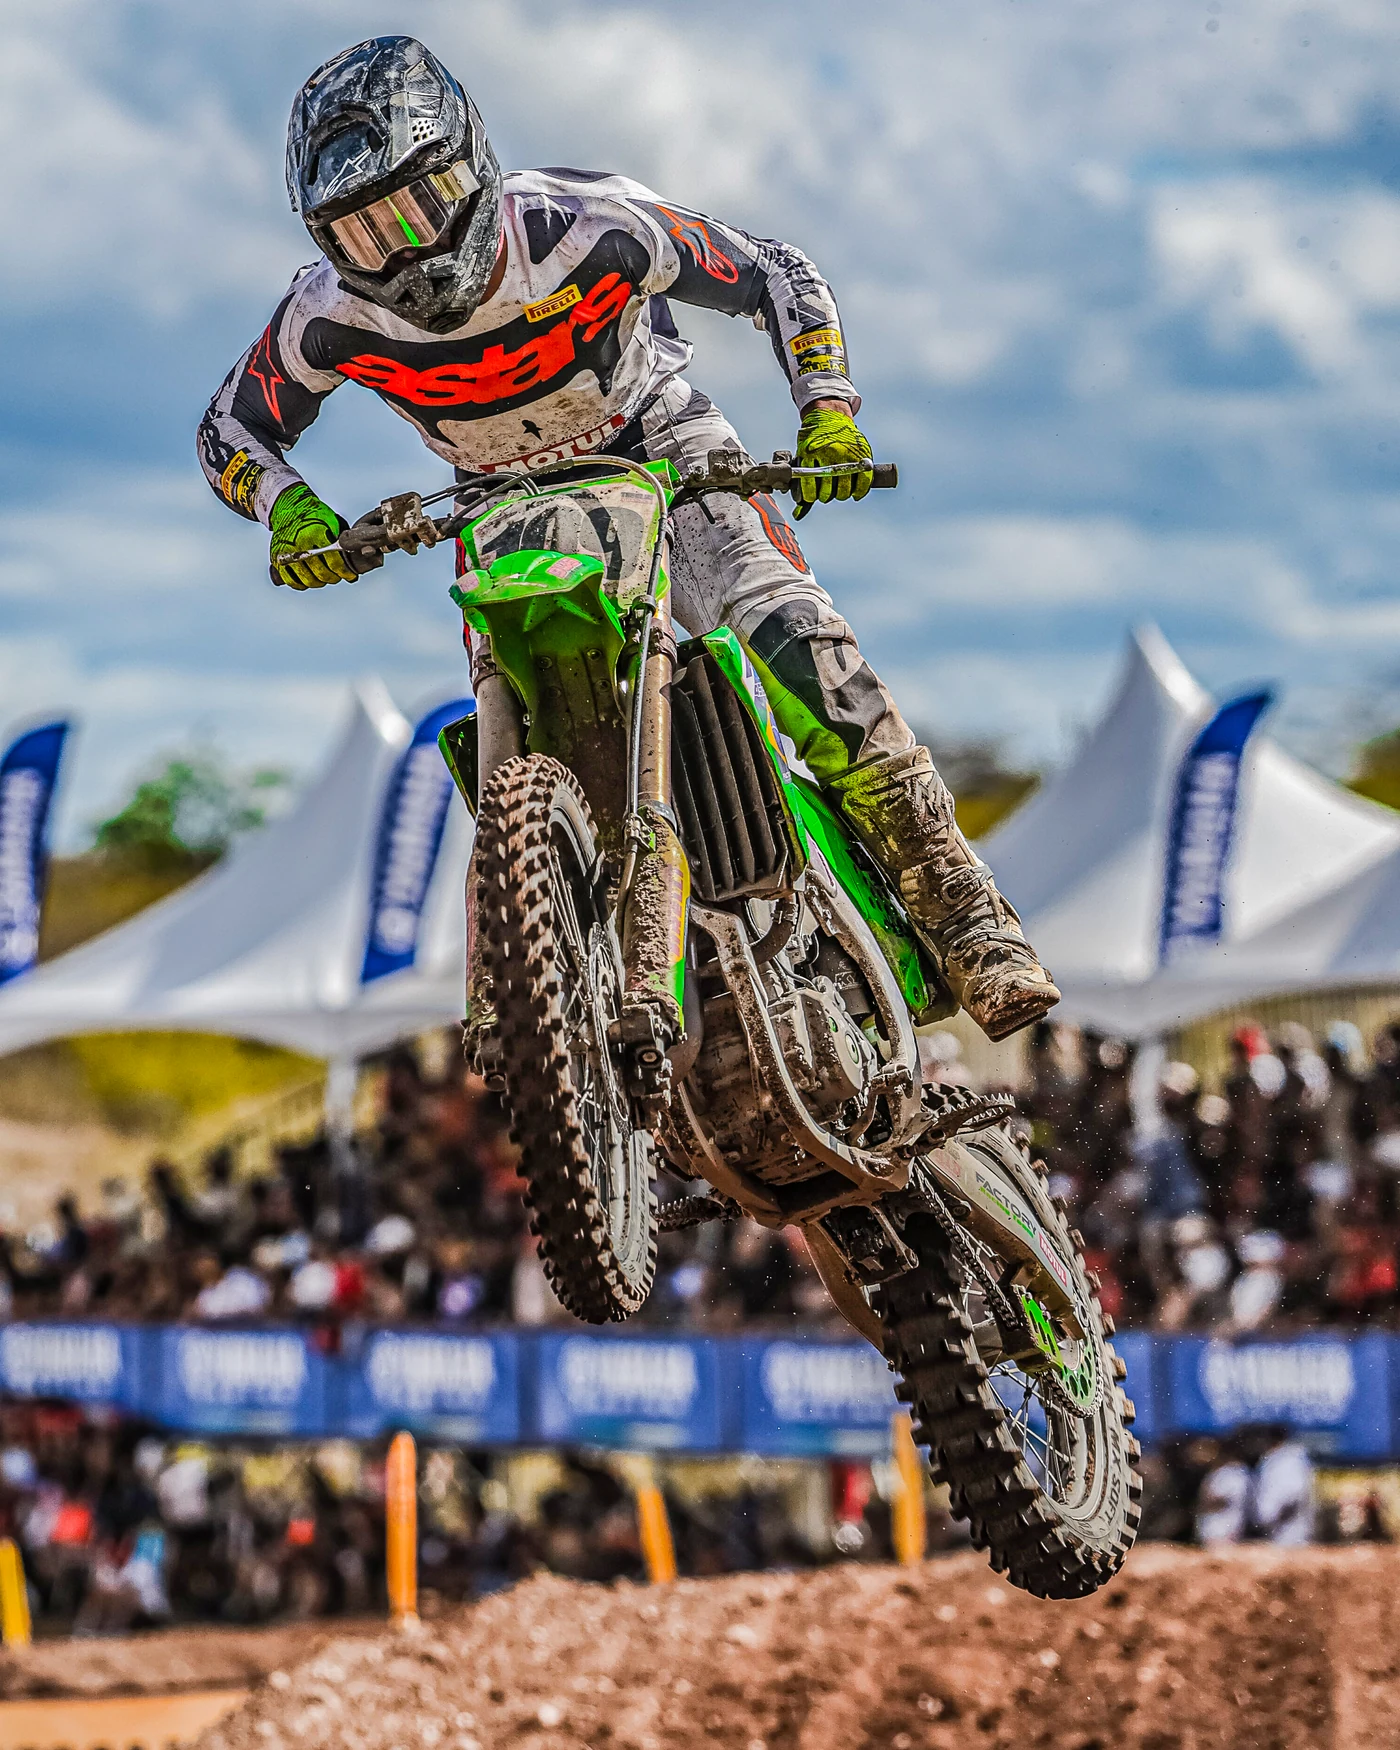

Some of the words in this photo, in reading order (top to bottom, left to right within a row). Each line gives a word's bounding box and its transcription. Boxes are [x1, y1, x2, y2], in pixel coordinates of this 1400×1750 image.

[527, 288, 577, 319] PIRELLI
[335, 272, 632, 406] astars
[494, 420, 616, 474] MOTUL
[975, 1171, 1037, 1235] FACTORY
[1040, 1237, 1067, 1285] MOTUL
[1104, 1473, 1121, 1526] SOFT
